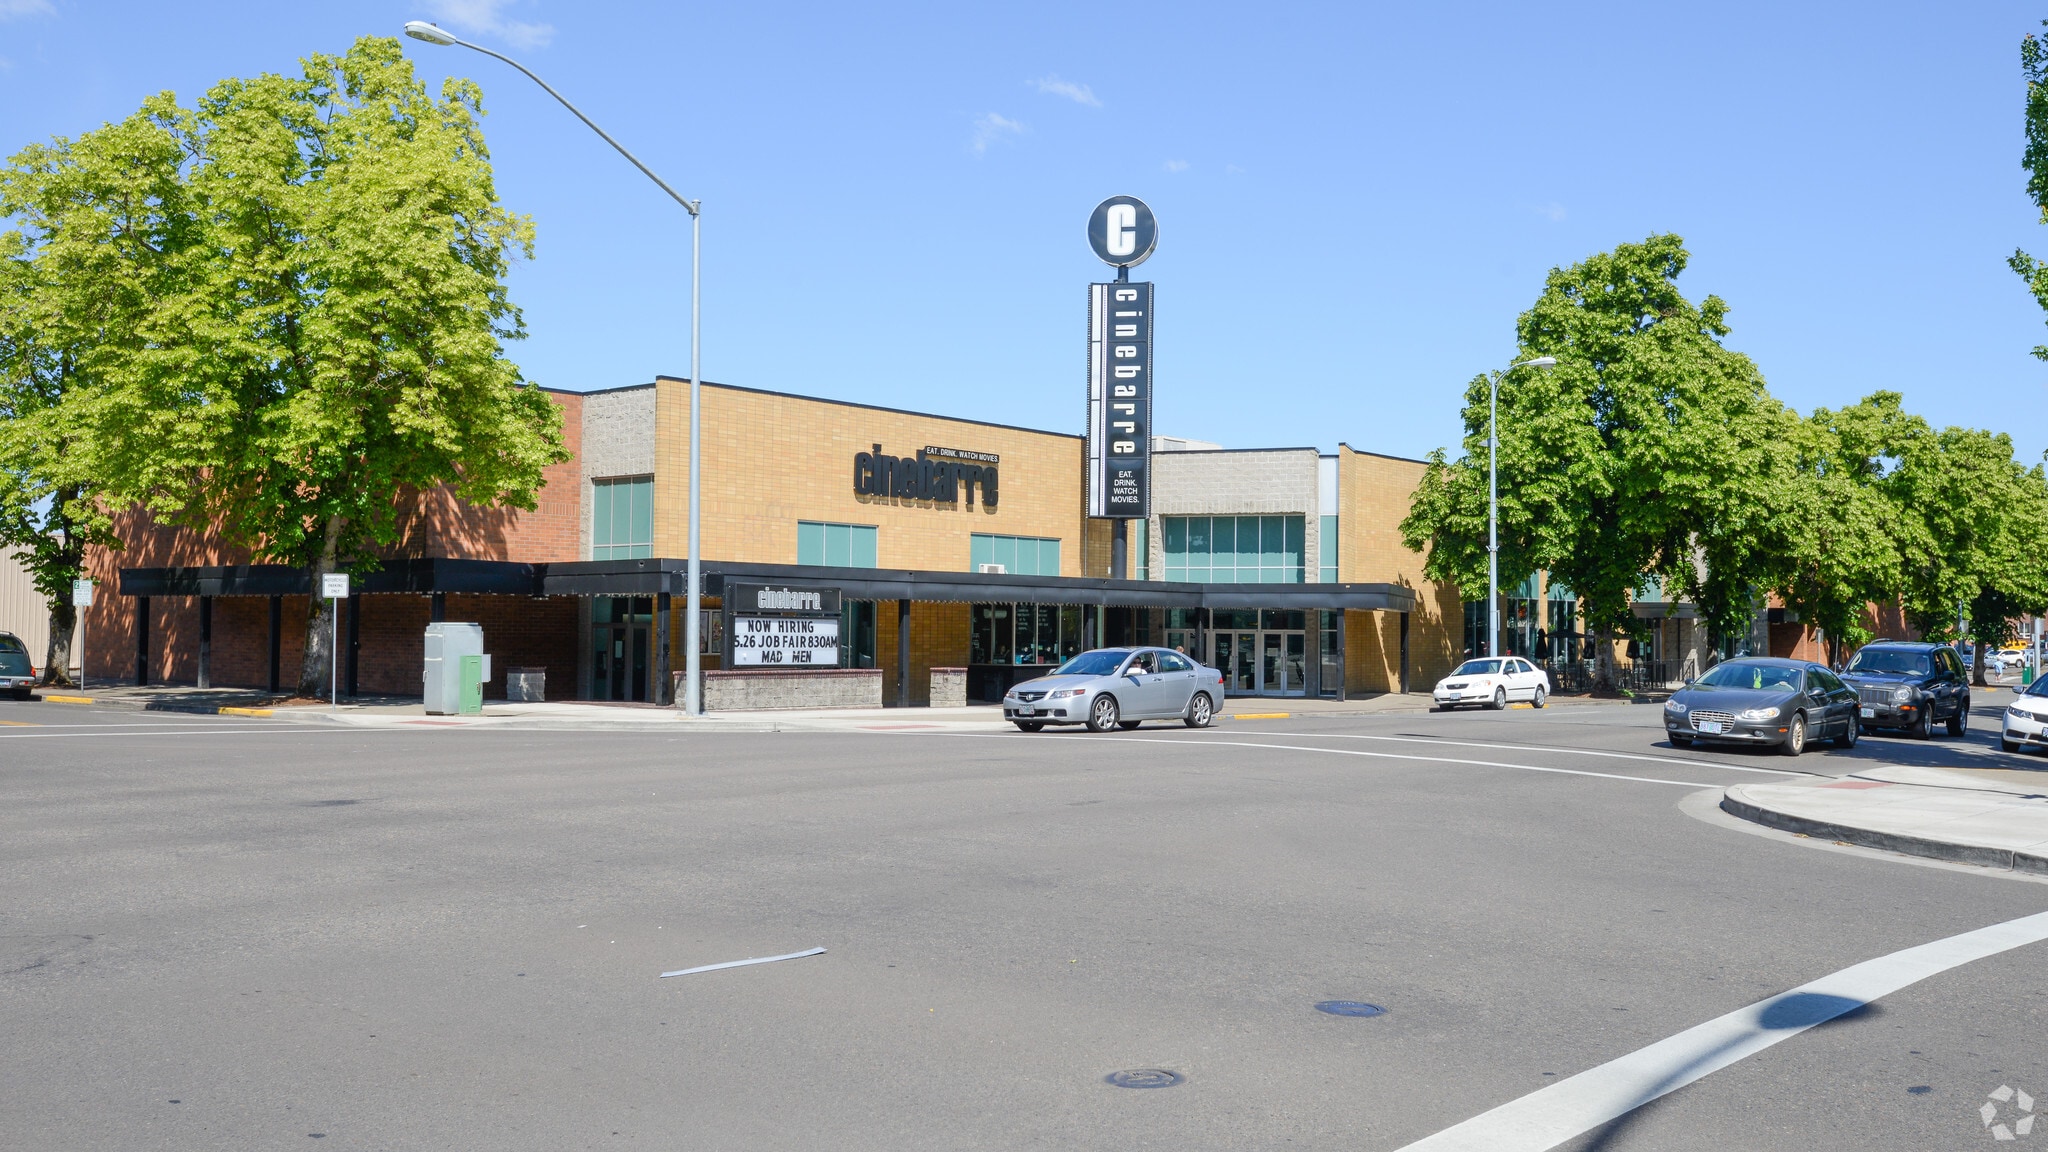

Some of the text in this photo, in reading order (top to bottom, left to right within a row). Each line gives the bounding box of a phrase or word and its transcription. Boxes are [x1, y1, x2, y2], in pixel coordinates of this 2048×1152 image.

[1107, 204, 1136, 256] C
[1113, 289, 1143, 454] cinebarre
[926, 447, 940, 456] EAT.
[940, 449, 958, 458] DRINK.
[959, 452, 979, 460] WATCH
[854, 443, 999, 506] cinebarre
[1118, 470, 1133, 479] EAT.
[1113, 479, 1138, 487] DRINK.
[1113, 487, 1138, 495] WATCH
[1111, 495, 1140, 504] MOVIES.
[748, 619, 814, 633] NOW HIRING
[734, 635, 838, 649] 5.26 JOB FAIR 830AM
[761, 650, 812, 663] MAD MEN
